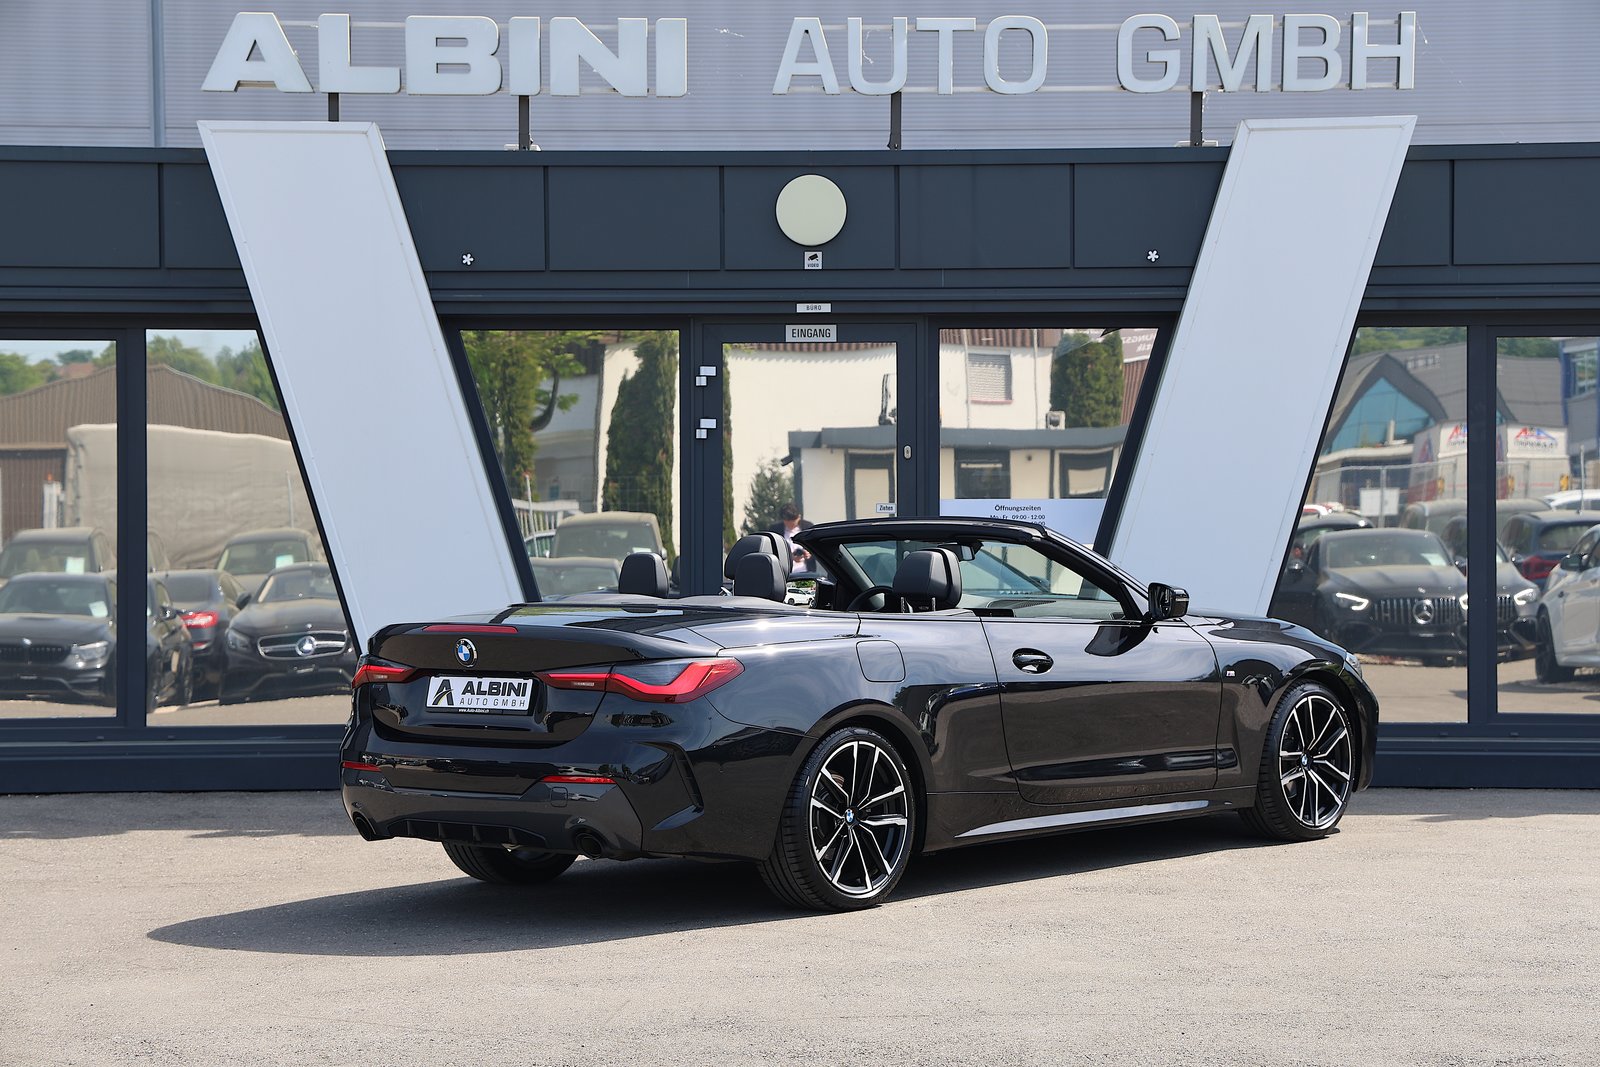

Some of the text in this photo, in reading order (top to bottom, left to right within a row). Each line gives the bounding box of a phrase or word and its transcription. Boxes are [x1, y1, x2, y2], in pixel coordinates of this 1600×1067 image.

[201, 11, 1417, 97] ALBINI AUTO GMBH
[791, 328, 831, 338] EINGANG
[994, 504, 1042, 512] Öffnungszeiten
[461, 681, 528, 696] ALBINI
[460, 698, 526, 706] AUTO GMBH
